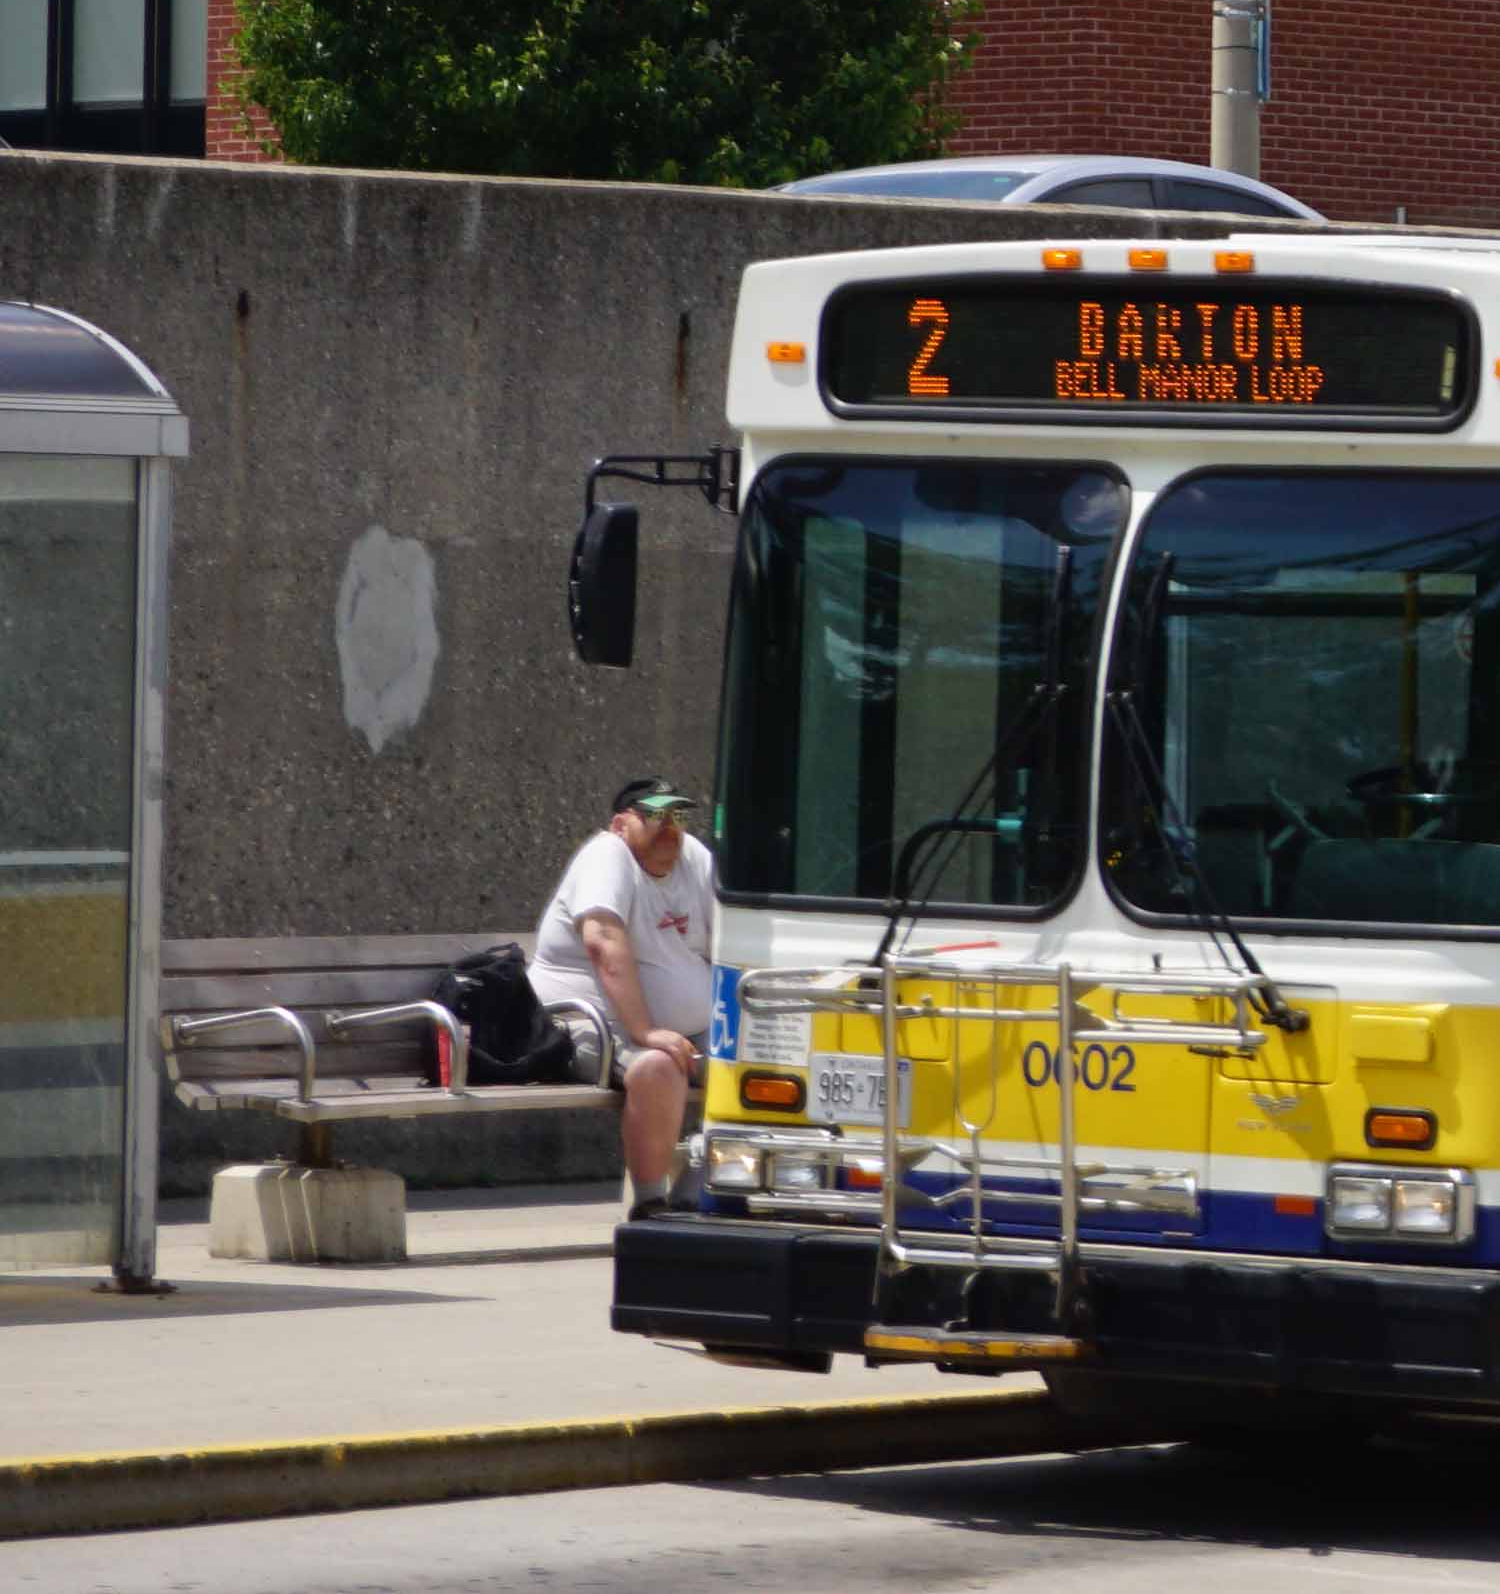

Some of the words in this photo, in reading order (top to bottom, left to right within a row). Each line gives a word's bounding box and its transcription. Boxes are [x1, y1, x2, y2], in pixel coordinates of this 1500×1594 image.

[906, 297, 951, 397] 2
[1054, 359, 1126, 398] BELL
[1250, 363, 1326, 404] LOOP
[818, 1070, 853, 1104] 985
[1023, 1040, 1137, 1092] 0602
